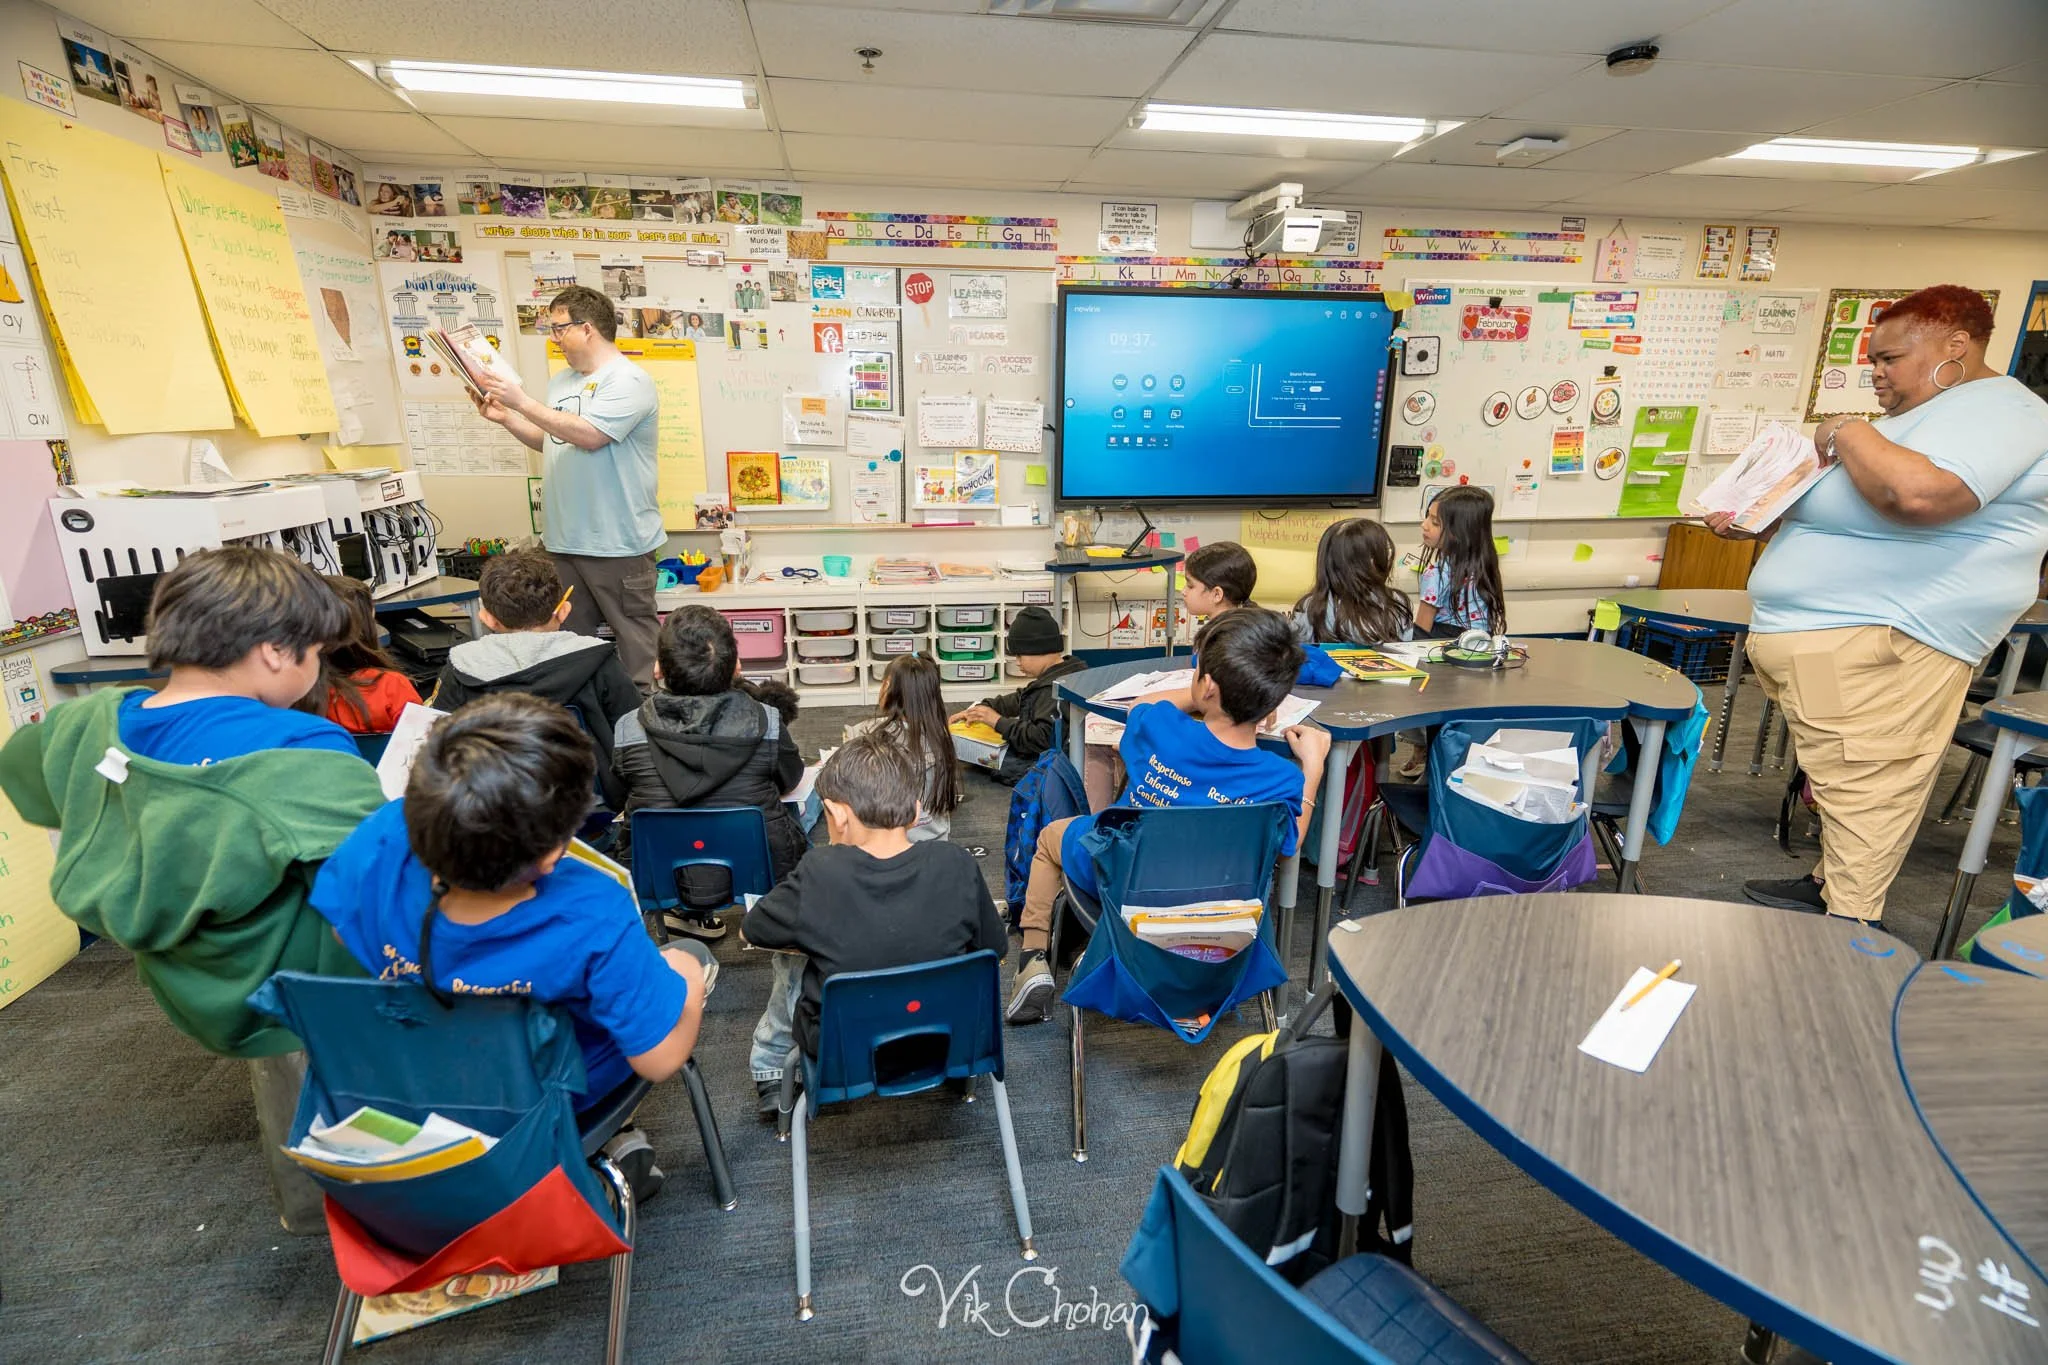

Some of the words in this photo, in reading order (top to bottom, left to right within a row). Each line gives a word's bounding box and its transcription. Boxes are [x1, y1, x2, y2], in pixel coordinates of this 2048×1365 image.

[583, 228, 592, 239] is
[594, 228, 605, 239] in
[607, 231, 632, 241] your
[637, 230, 666, 242] heart
[668, 232, 686, 242] and
[750, 236, 769, 245] Muro
[770, 237, 780, 245] de
[827, 224, 845, 237] Aa
[856, 224, 873, 238] Bb
[885, 224, 902, 238] Cc
[914, 224, 933, 239] Dd
[947, 225, 962, 240] Ee
[977, 226, 989, 240] Ff
[1002, 227, 1022, 244] Gg
[1034, 227, 1051, 242] Hh
[1389, 239, 1405, 252] Uu
[1426, 239, 1440, 252] Vv
[1458, 240, 1479, 252] Ww
[1491, 240, 1507, 253] Xx
[1528, 241, 1541, 255] Yy
[1563, 242, 1577, 256] Zz
[1063, 265, 1074, 279] Ii
[1090, 265, 1101, 281] Jj
[1119, 266, 1134, 280] Kk
[1151, 266, 1161, 280] Ll
[1175, 266, 1197, 280] Mm
[1204, 267, 1221, 280] Nn
[1257, 267, 1270, 283] Pp
[1283, 268, 1301, 285] Qq
[1314, 269, 1326, 282] Rr
[1339, 270, 1352, 283] Ss
[1364, 270, 1376, 283] Tt
[405, 279, 428, 291] Dual
[430, 280, 479, 293] Language
[813, 275, 843, 291] epic!
[905, 281, 933, 297] STOP
[954, 288, 1003, 300] LEARNING
[1416, 292, 1447, 301] Winter
[1458, 287, 1485, 296] Months
[1486, 288, 1494, 296] of
[1495, 288, 1508, 296] the
[1758, 308, 1796, 318] LEARNING
[1840, 307, 1850, 321] C
[3, 314, 23, 334] ay
[1478, 317, 1517, 331] February
[969, 331, 1005, 340] READING
[1110, 333, 1152, 347] 09:37
[934, 353, 968, 362] LEARNING
[1000, 355, 1032, 364] SUCCESS
[27, 413, 50, 427] aw
[1659, 410, 1683, 420] Math
[963, 464, 995, 492] WHOOSH!
[1148, 753, 1192, 787] Respetuoso
[1144, 771, 1180, 799] Enfocado
